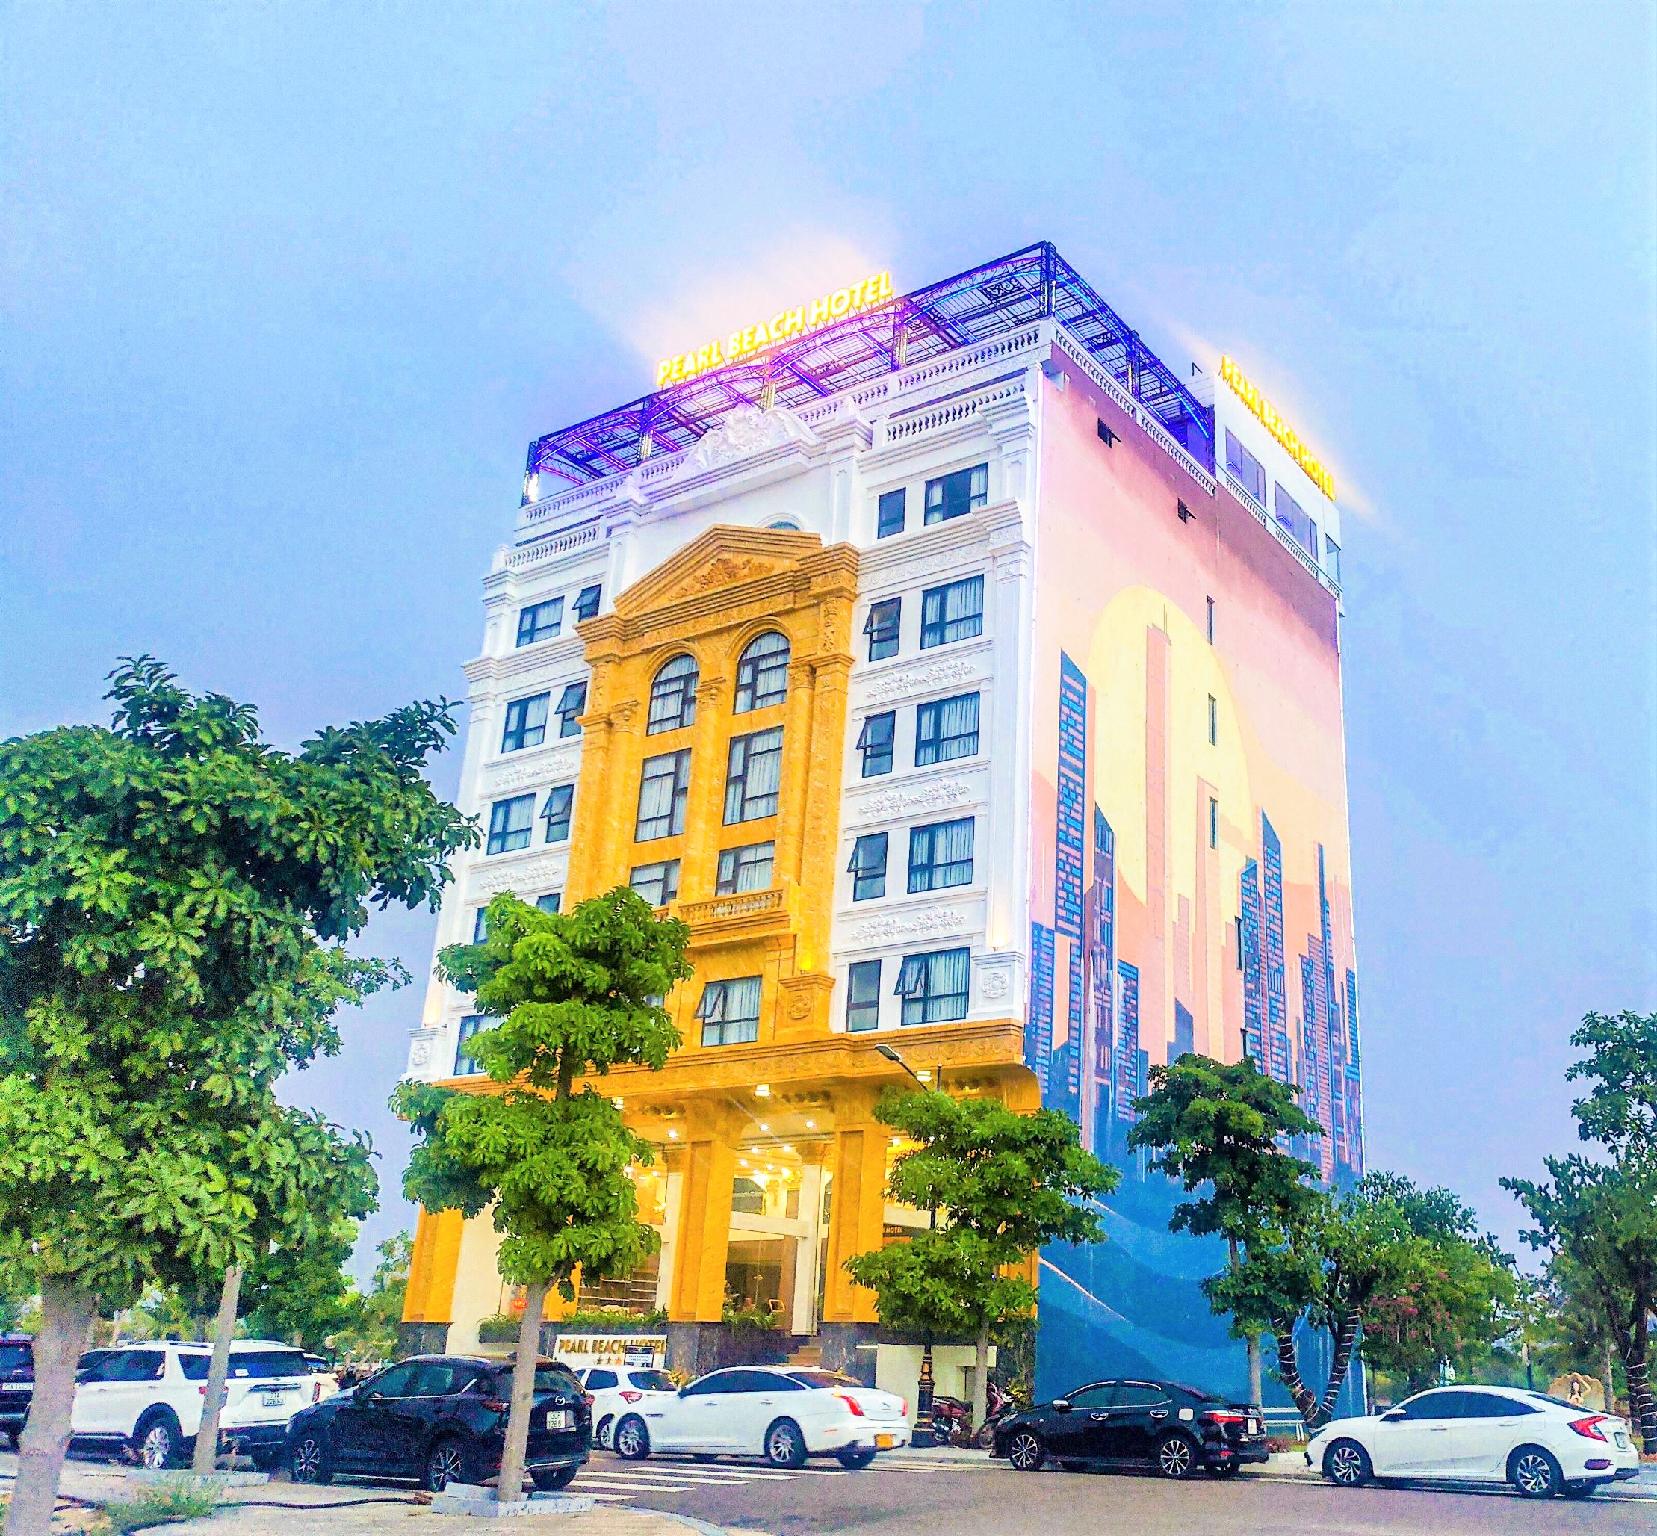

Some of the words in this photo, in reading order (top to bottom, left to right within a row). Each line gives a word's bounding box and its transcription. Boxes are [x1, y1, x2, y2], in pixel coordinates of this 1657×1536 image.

[656, 339, 723, 386] PEARL
[727, 305, 805, 358] BEACH
[809, 271, 893, 325] HOTEL
[559, 1339, 589, 1354] PEARL
[592, 1339, 625, 1354] BEACH
